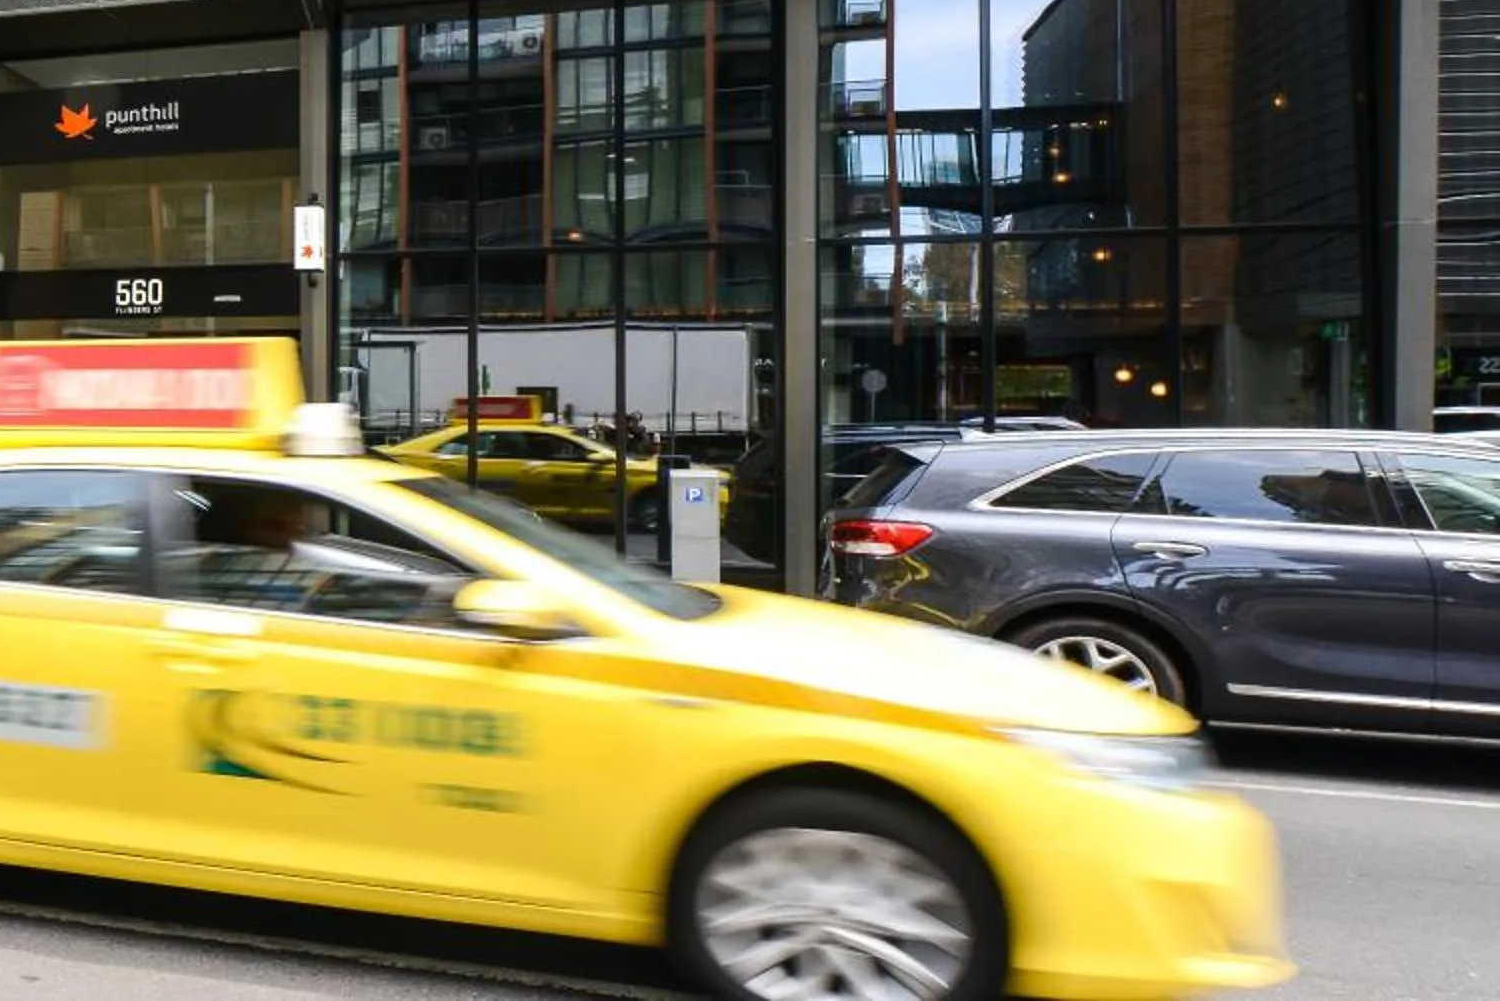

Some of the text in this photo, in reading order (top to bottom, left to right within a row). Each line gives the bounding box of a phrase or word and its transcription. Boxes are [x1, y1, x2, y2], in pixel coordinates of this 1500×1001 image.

[105, 101, 179, 128] punthill
[116, 279, 163, 306] 560
[689, 487, 701, 501] P
